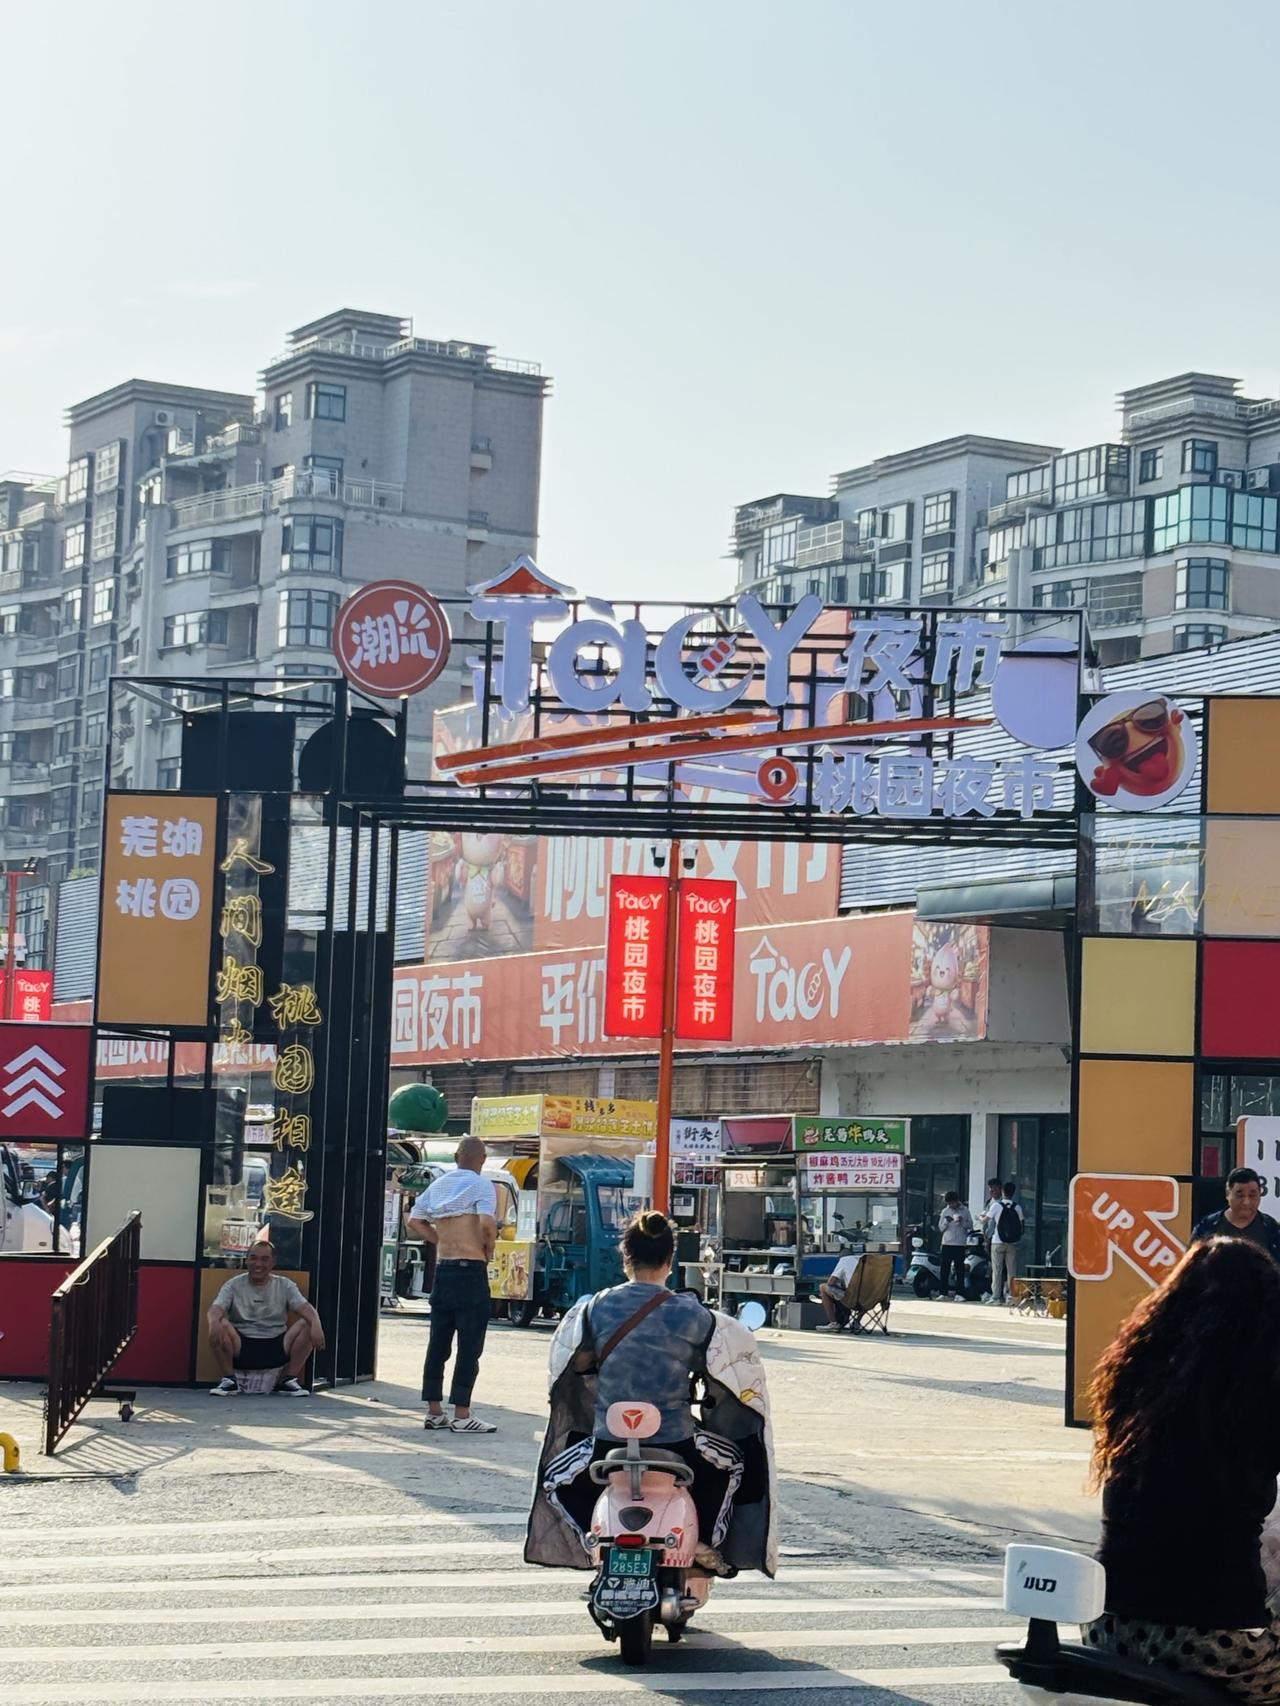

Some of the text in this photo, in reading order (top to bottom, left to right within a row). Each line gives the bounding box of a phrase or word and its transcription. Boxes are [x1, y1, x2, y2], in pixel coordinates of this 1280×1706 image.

[350, 600, 437, 669] 潮流
[842, 614, 1009, 692] 夜市
[812, 751, 1060, 819] 桃园夜市
[119, 816, 203, 858] 芜湖
[116, 879, 200, 921] 桃园
[622, 916, 650, 1021] 桃园夜市
[693, 919, 720, 1024] 桃园夜市
[683, 1125, 720, 1143] 街头
[854, 1173, 895, 1185] 25元/只
[1091, 1191, 1177, 1268] UP UP
[613, 1562, 648, 1574] 285E3
